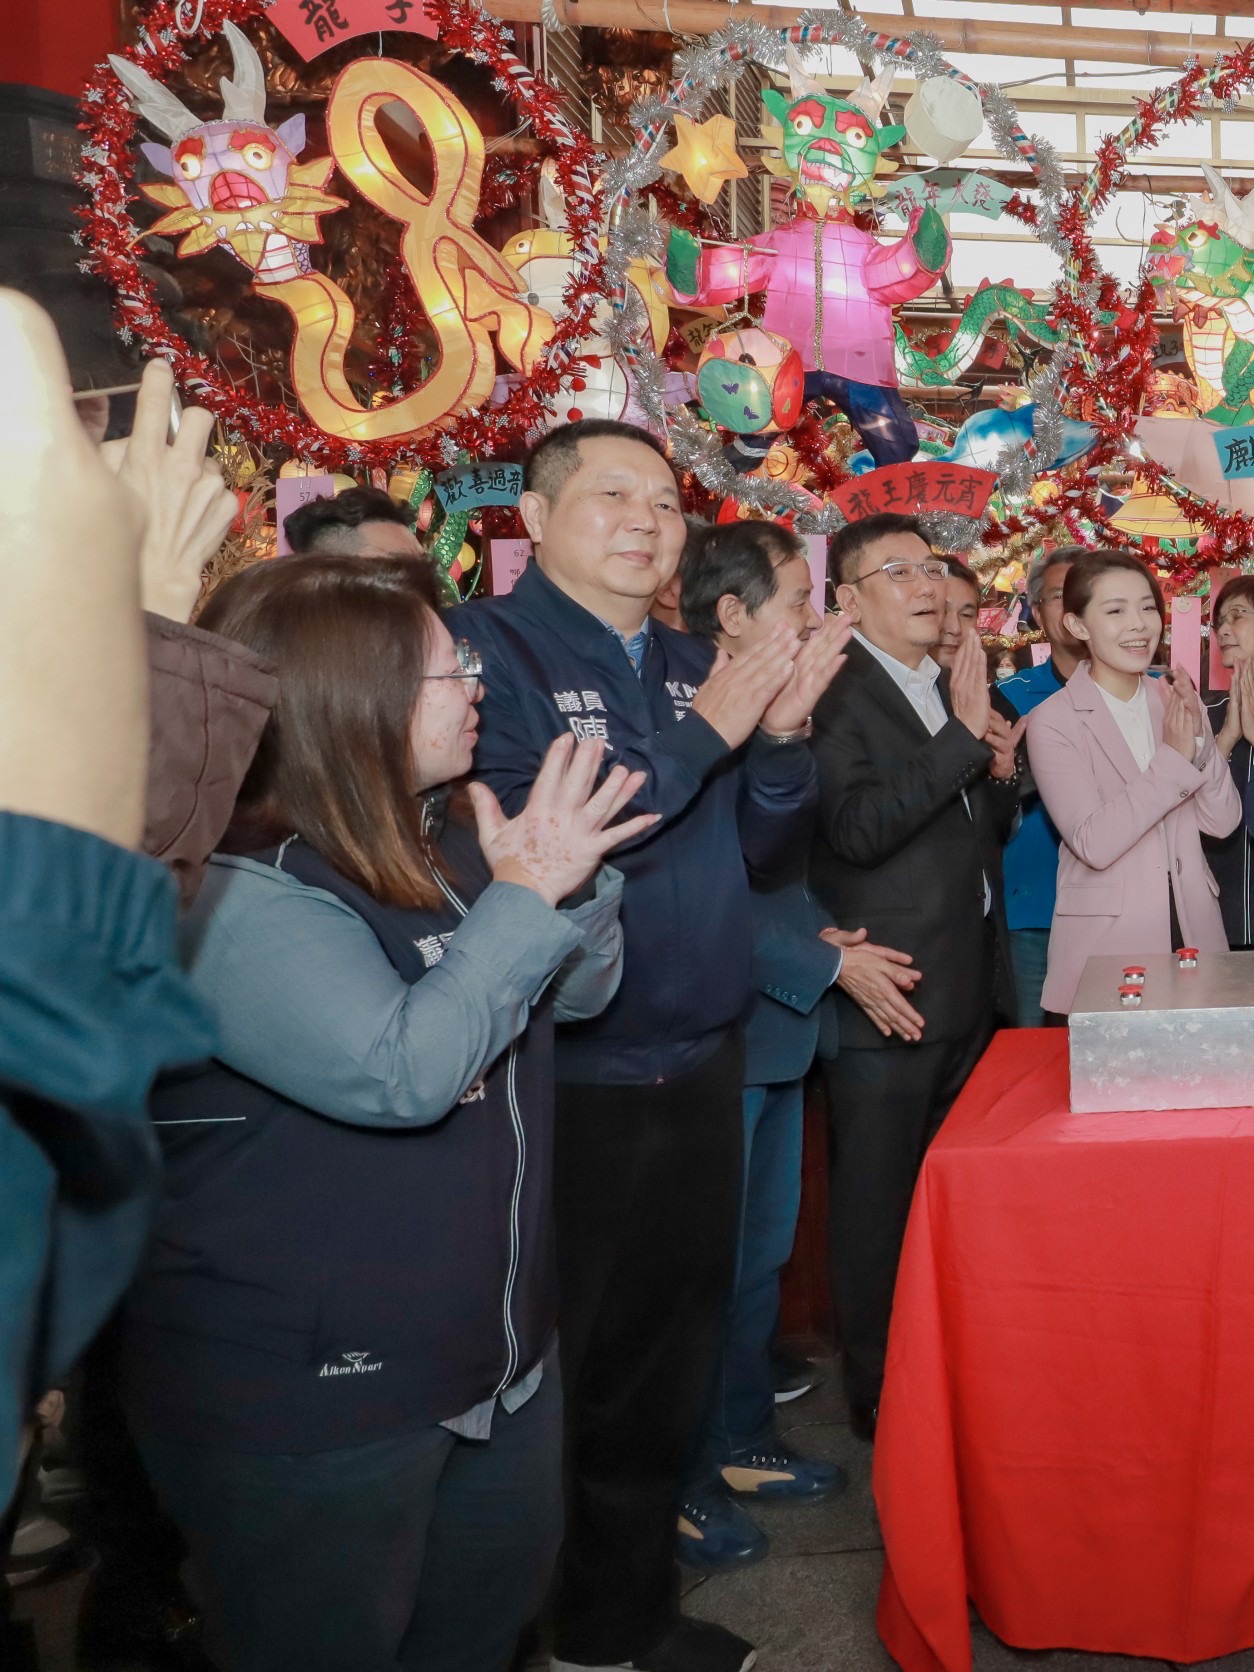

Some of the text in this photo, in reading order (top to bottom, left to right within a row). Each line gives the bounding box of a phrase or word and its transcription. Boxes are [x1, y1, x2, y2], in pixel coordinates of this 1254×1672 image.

[847, 470, 984, 518] 龍王慶元宵
[553, 690, 608, 713] 議員
